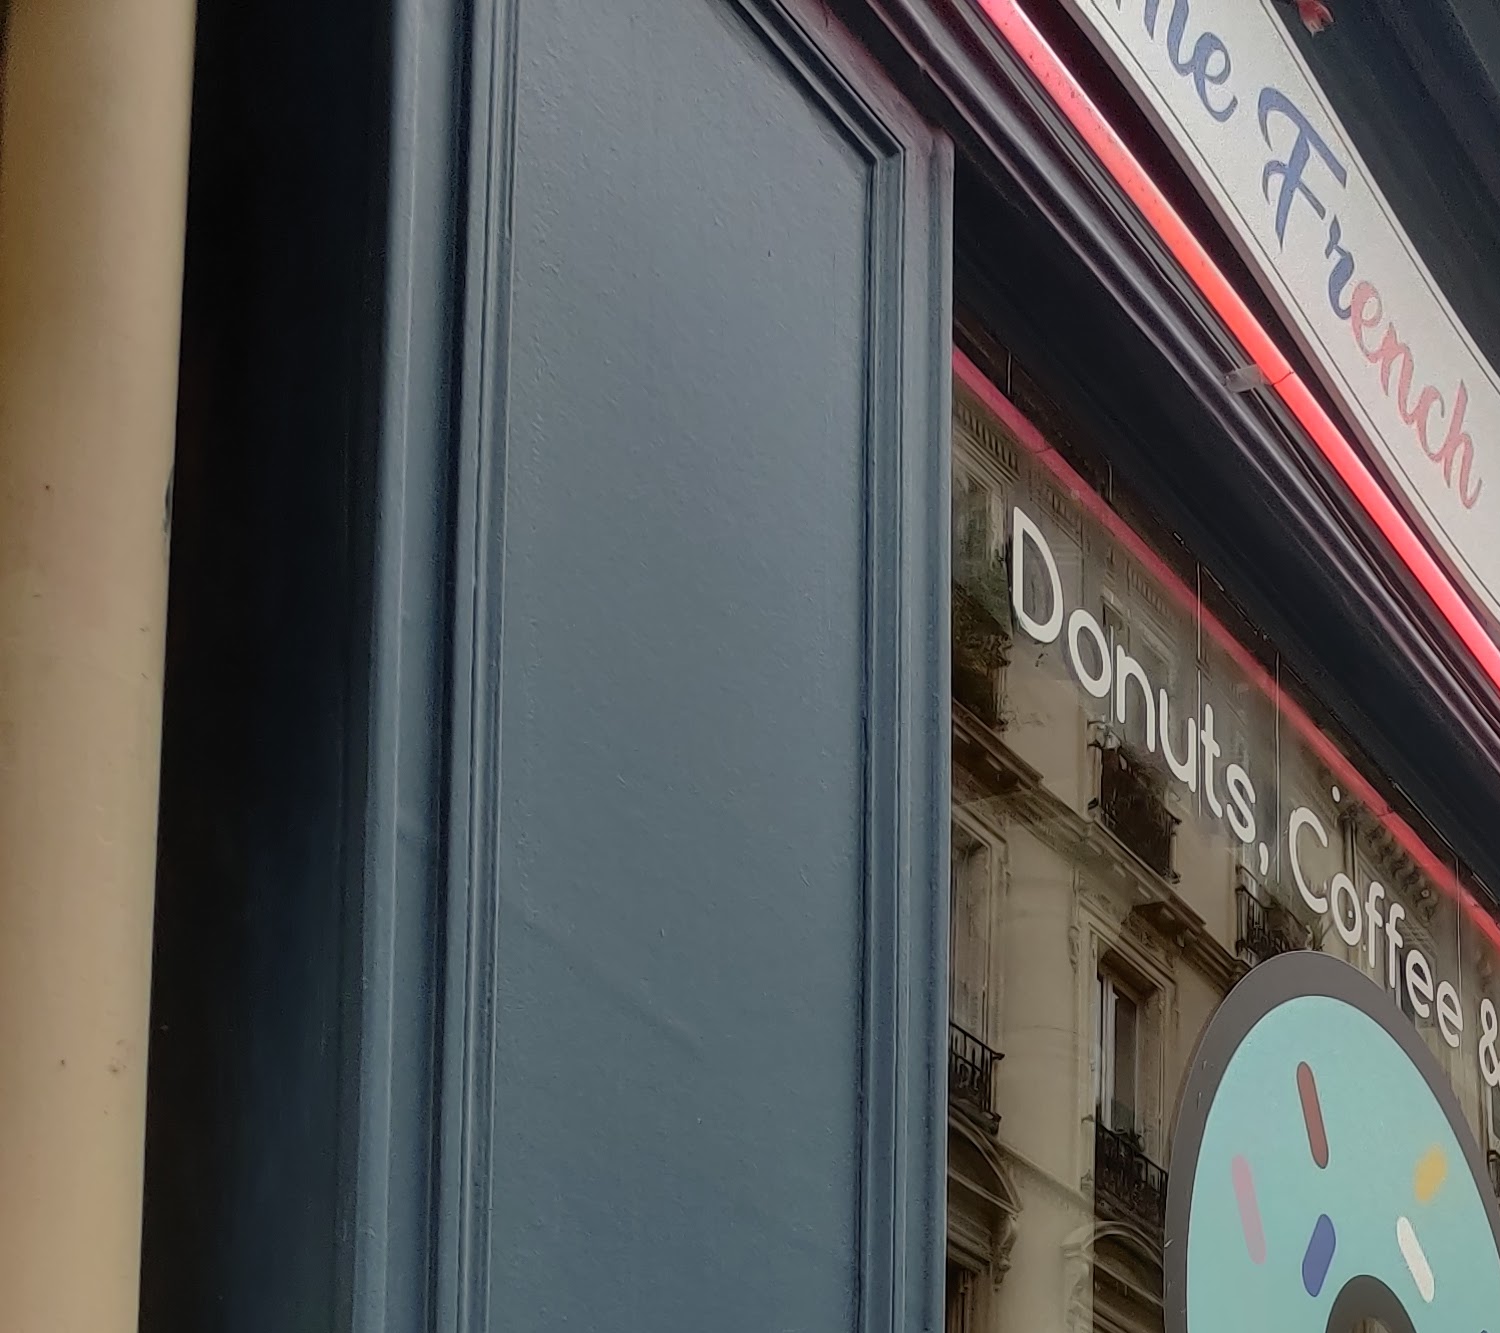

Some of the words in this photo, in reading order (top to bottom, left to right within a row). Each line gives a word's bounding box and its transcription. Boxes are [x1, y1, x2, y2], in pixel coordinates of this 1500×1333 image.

[1256, 84, 1483, 510] French
[1011, 505, 1270, 876] Donuts,
[1289, 807, 1465, 1048] Coffee
